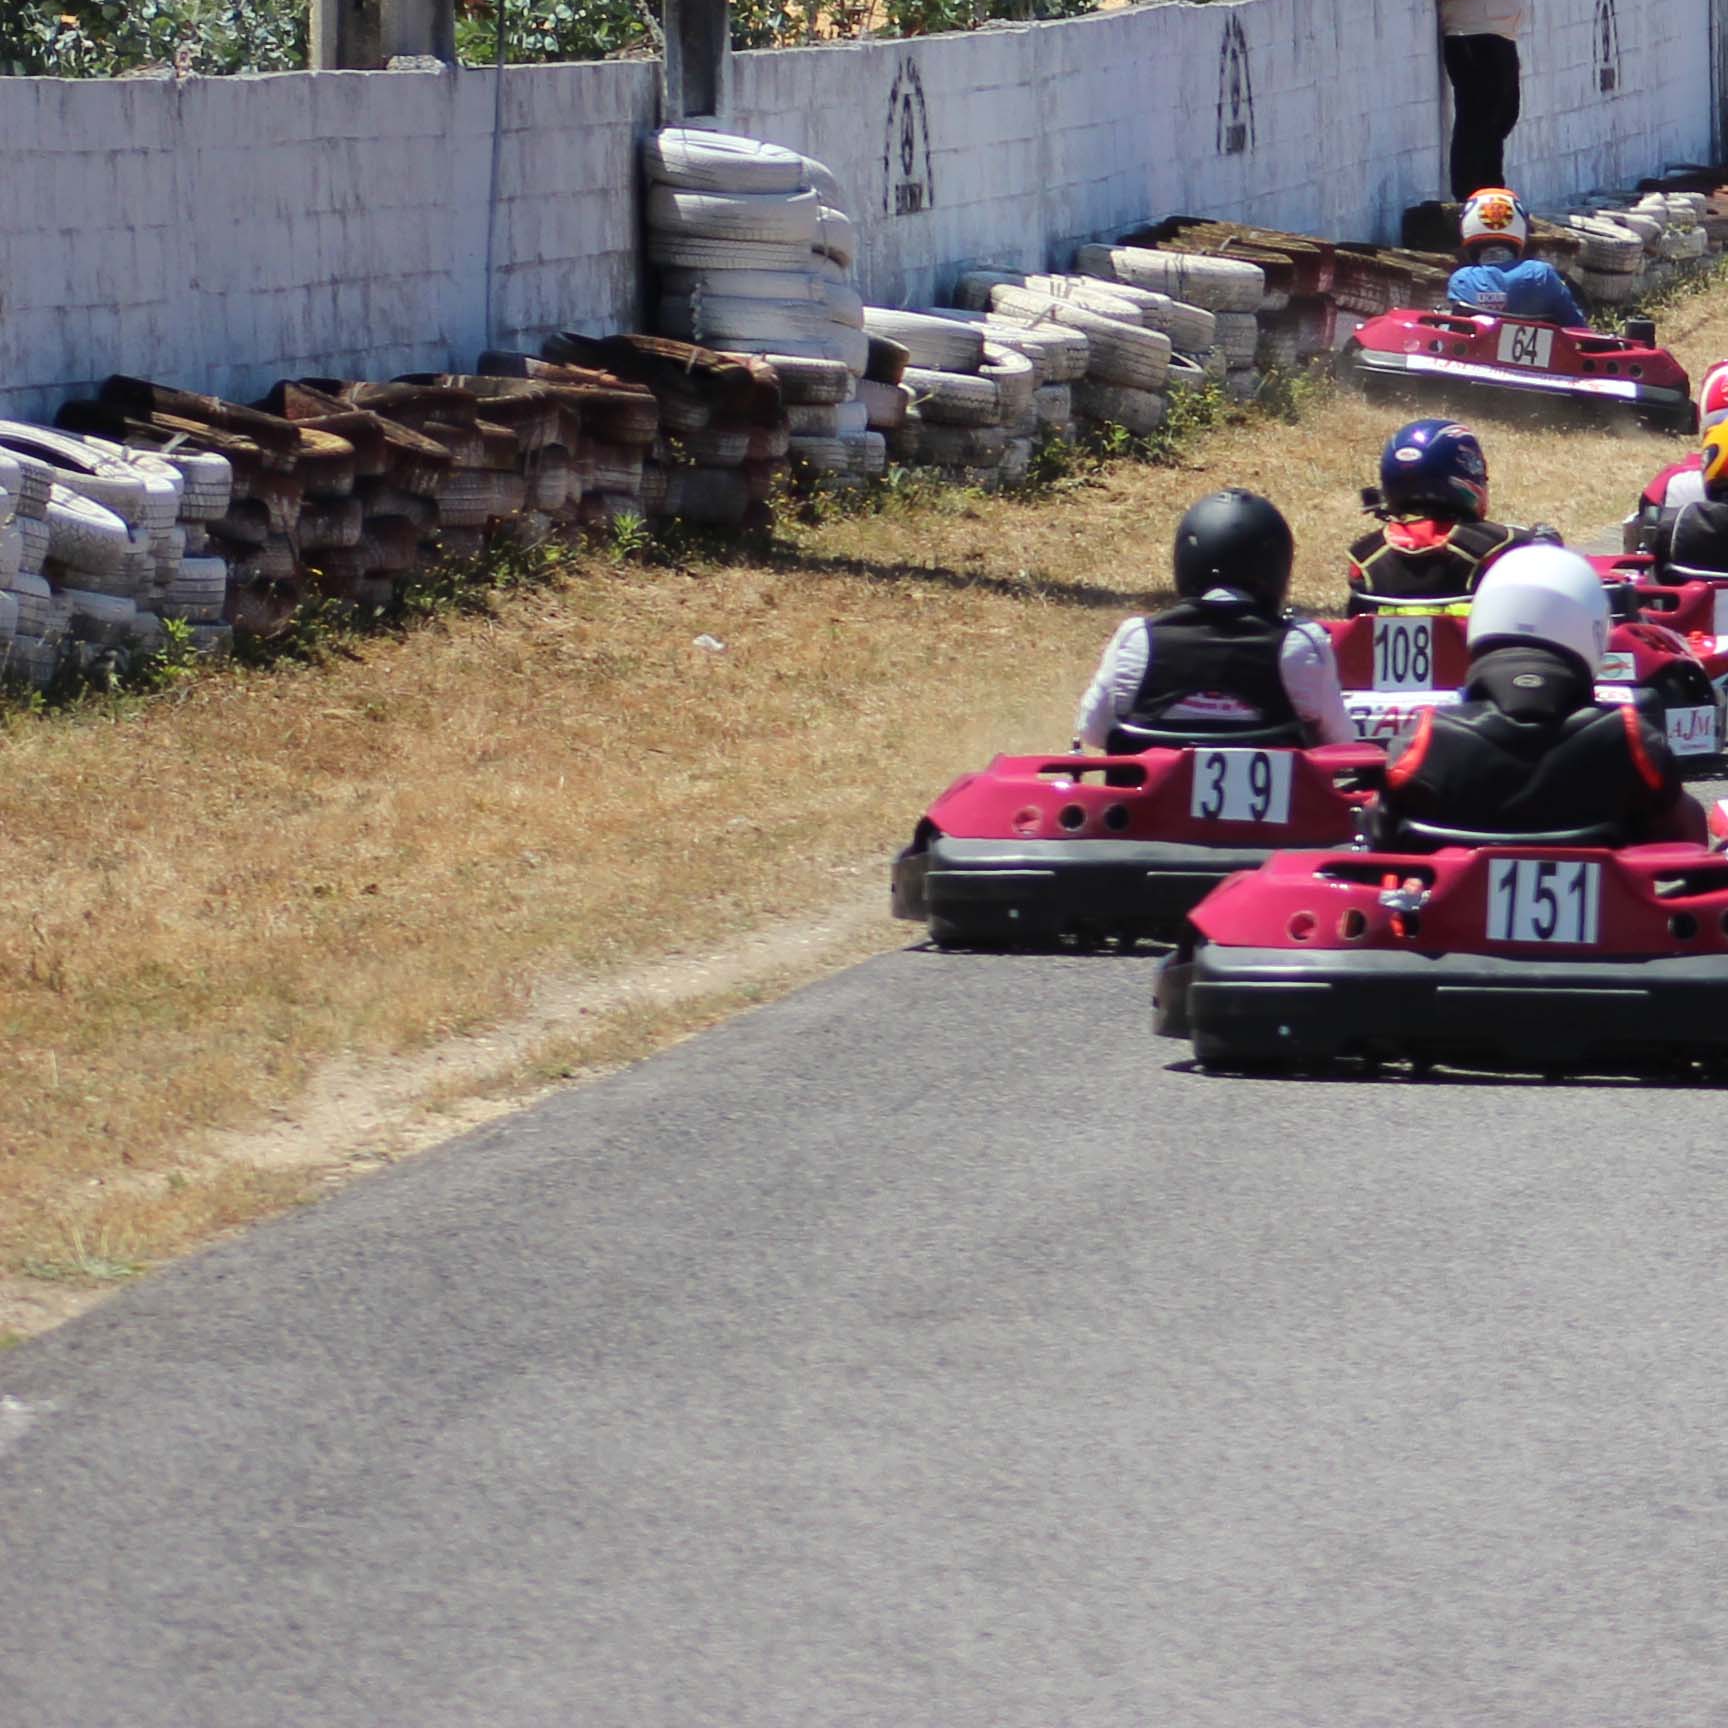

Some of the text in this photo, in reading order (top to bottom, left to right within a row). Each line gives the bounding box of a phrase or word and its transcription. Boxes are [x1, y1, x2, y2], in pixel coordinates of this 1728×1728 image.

[1512, 326, 1538, 365] 64
[1375, 623, 1430, 684] 108
[1201, 751, 1272, 821] 39
[1499, 860, 1586, 942] 151
